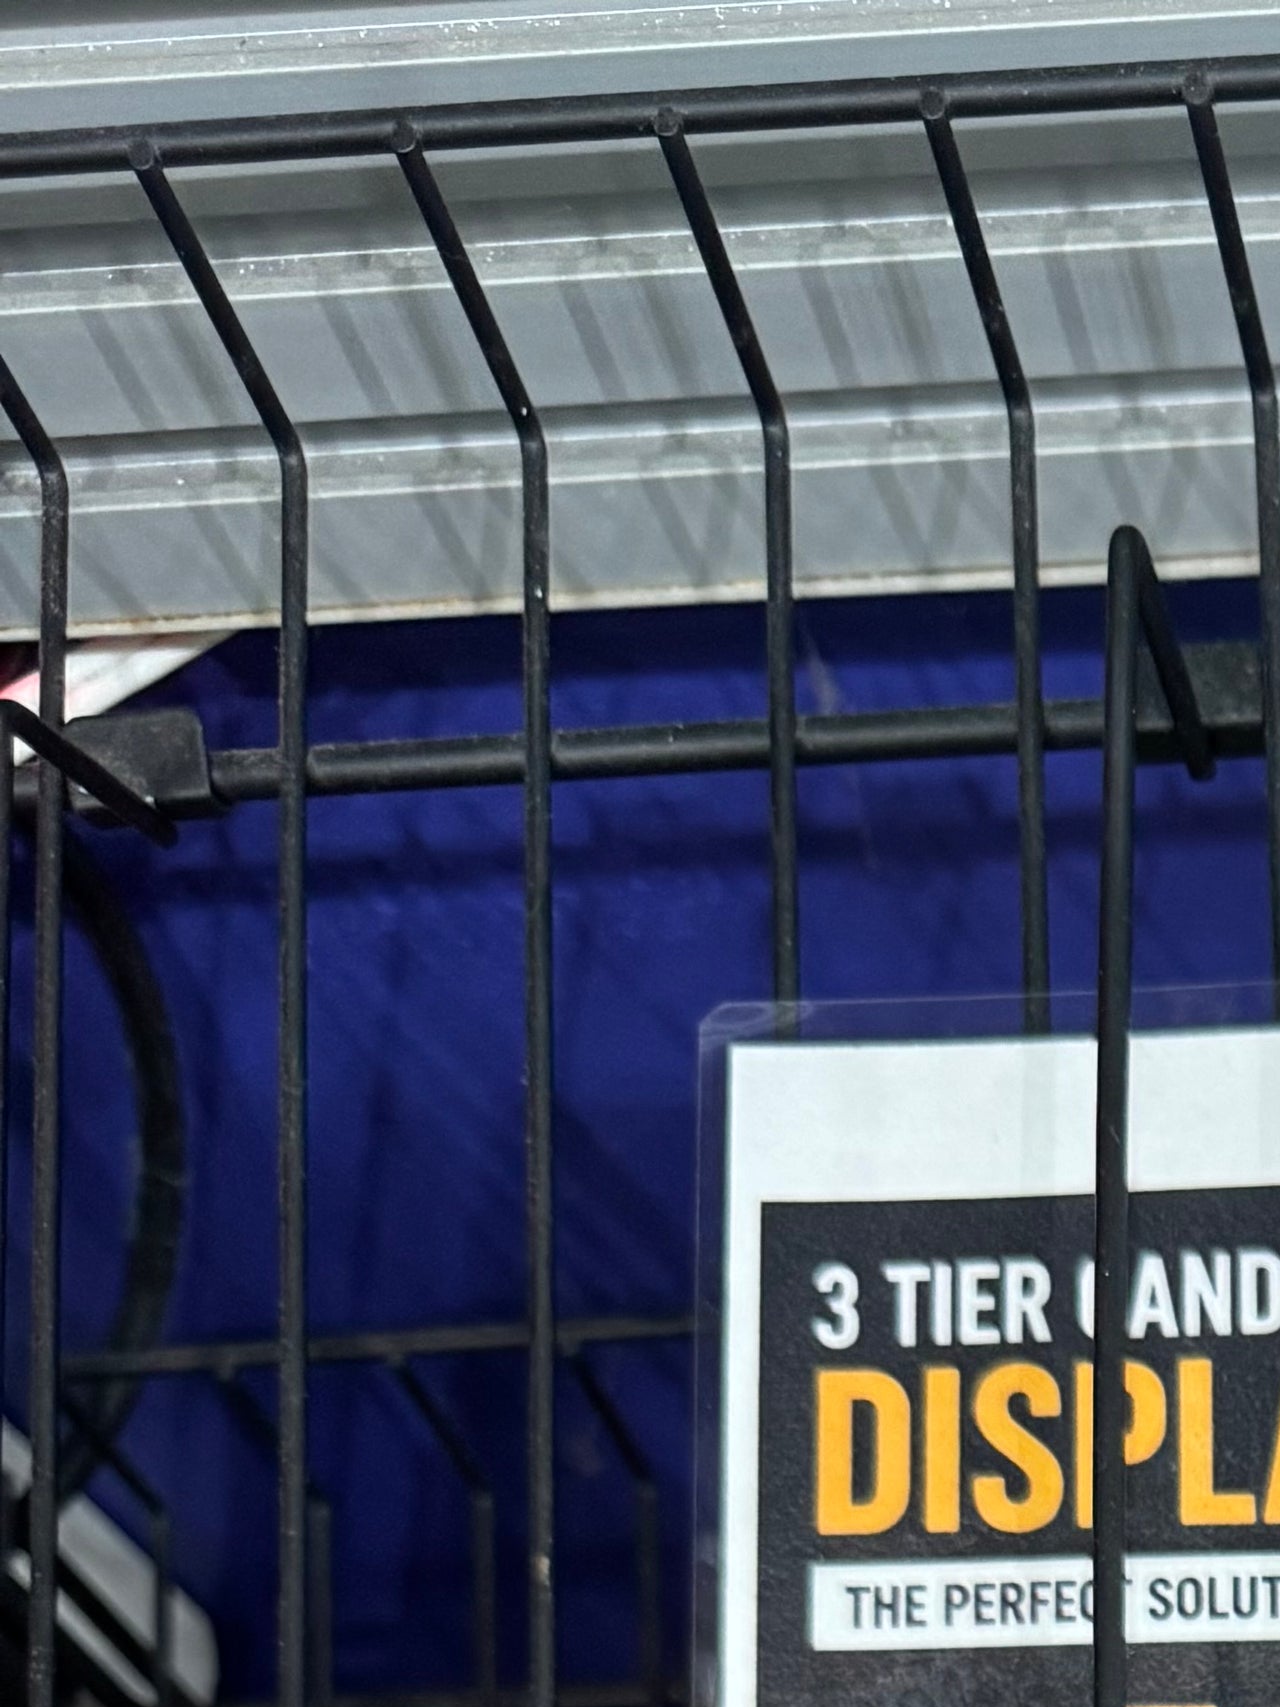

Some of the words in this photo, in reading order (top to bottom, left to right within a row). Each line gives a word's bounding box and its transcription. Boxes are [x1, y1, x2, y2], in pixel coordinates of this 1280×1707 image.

[812, 1260, 860, 1350] 3
[882, 1255, 1052, 1347] TIER
[846, 1585, 927, 1630] THE
[944, 1578, 1132, 1627] PERFEC
